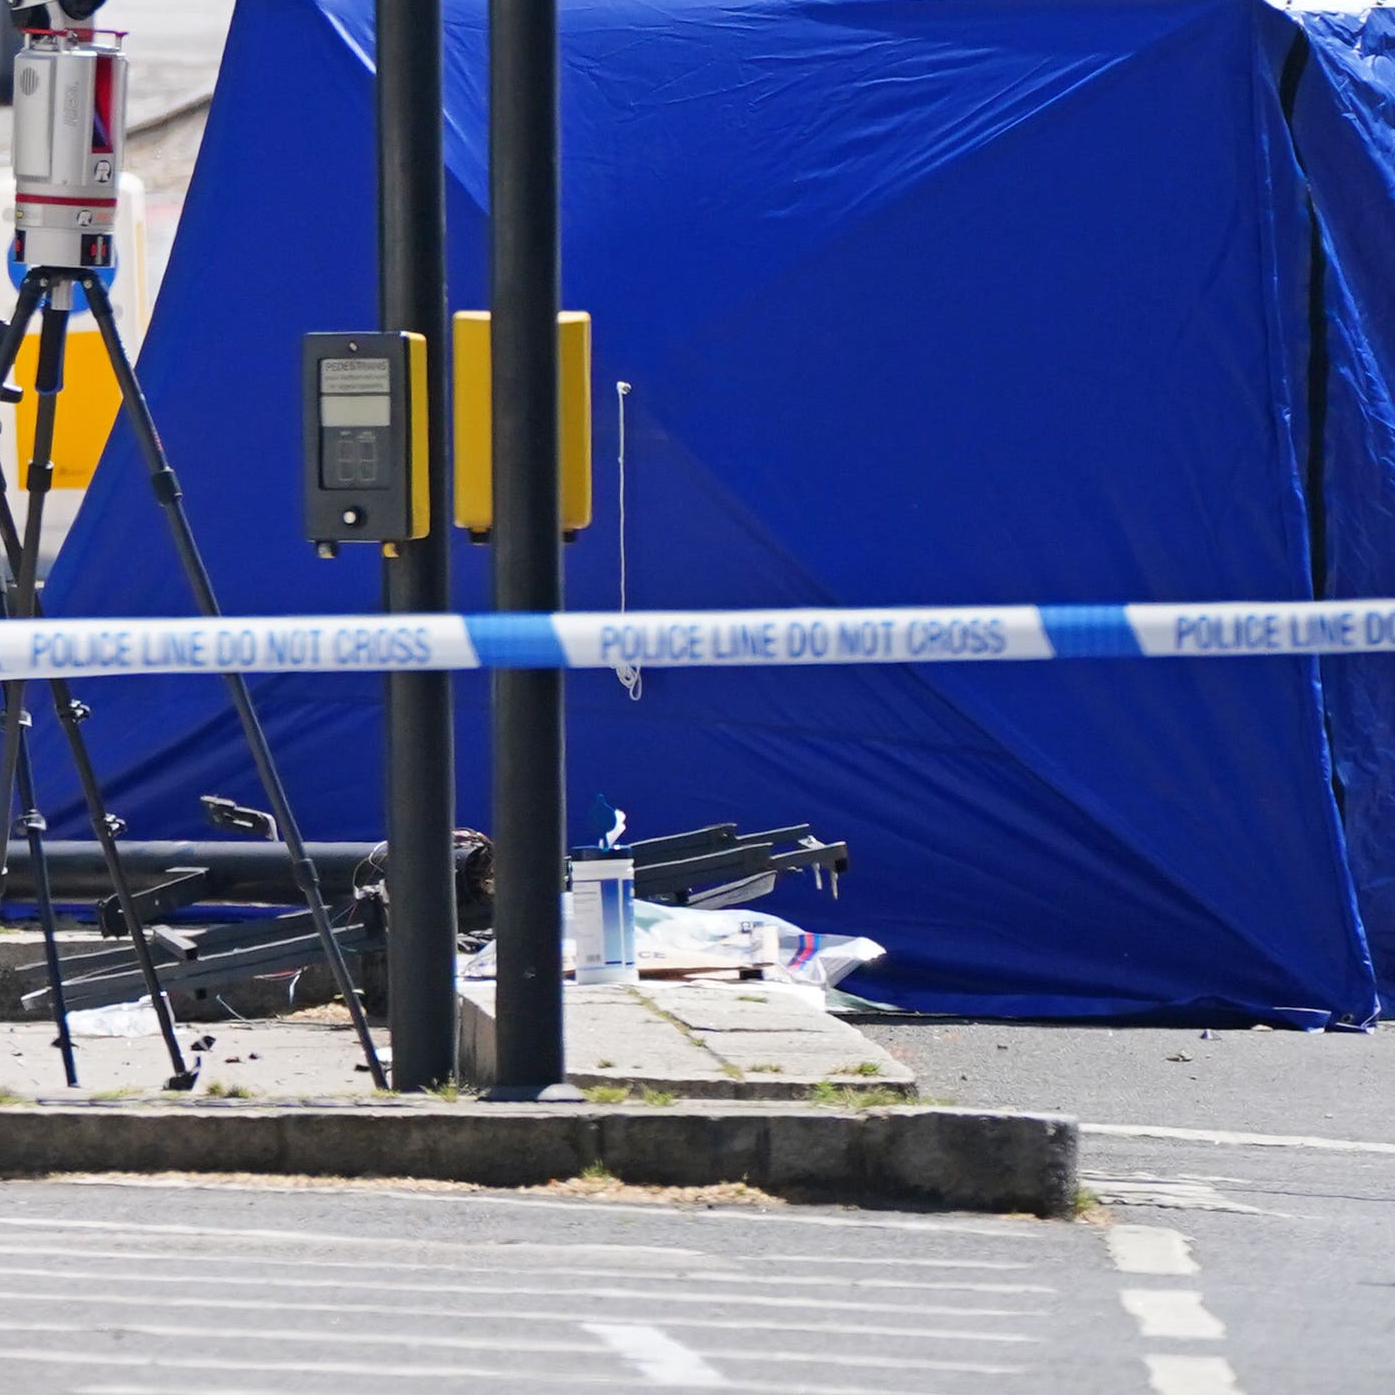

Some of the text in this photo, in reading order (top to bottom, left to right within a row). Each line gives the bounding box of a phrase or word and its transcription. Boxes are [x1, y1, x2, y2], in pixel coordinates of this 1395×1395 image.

[31, 627, 431, 669] POLICE LINE DO NOT CROSS
[601, 620, 1006, 659] POLICE LINE DO NOT CROSS
[1175, 617, 1278, 653] POLICE
[1290, 614, 1353, 652] LINE
